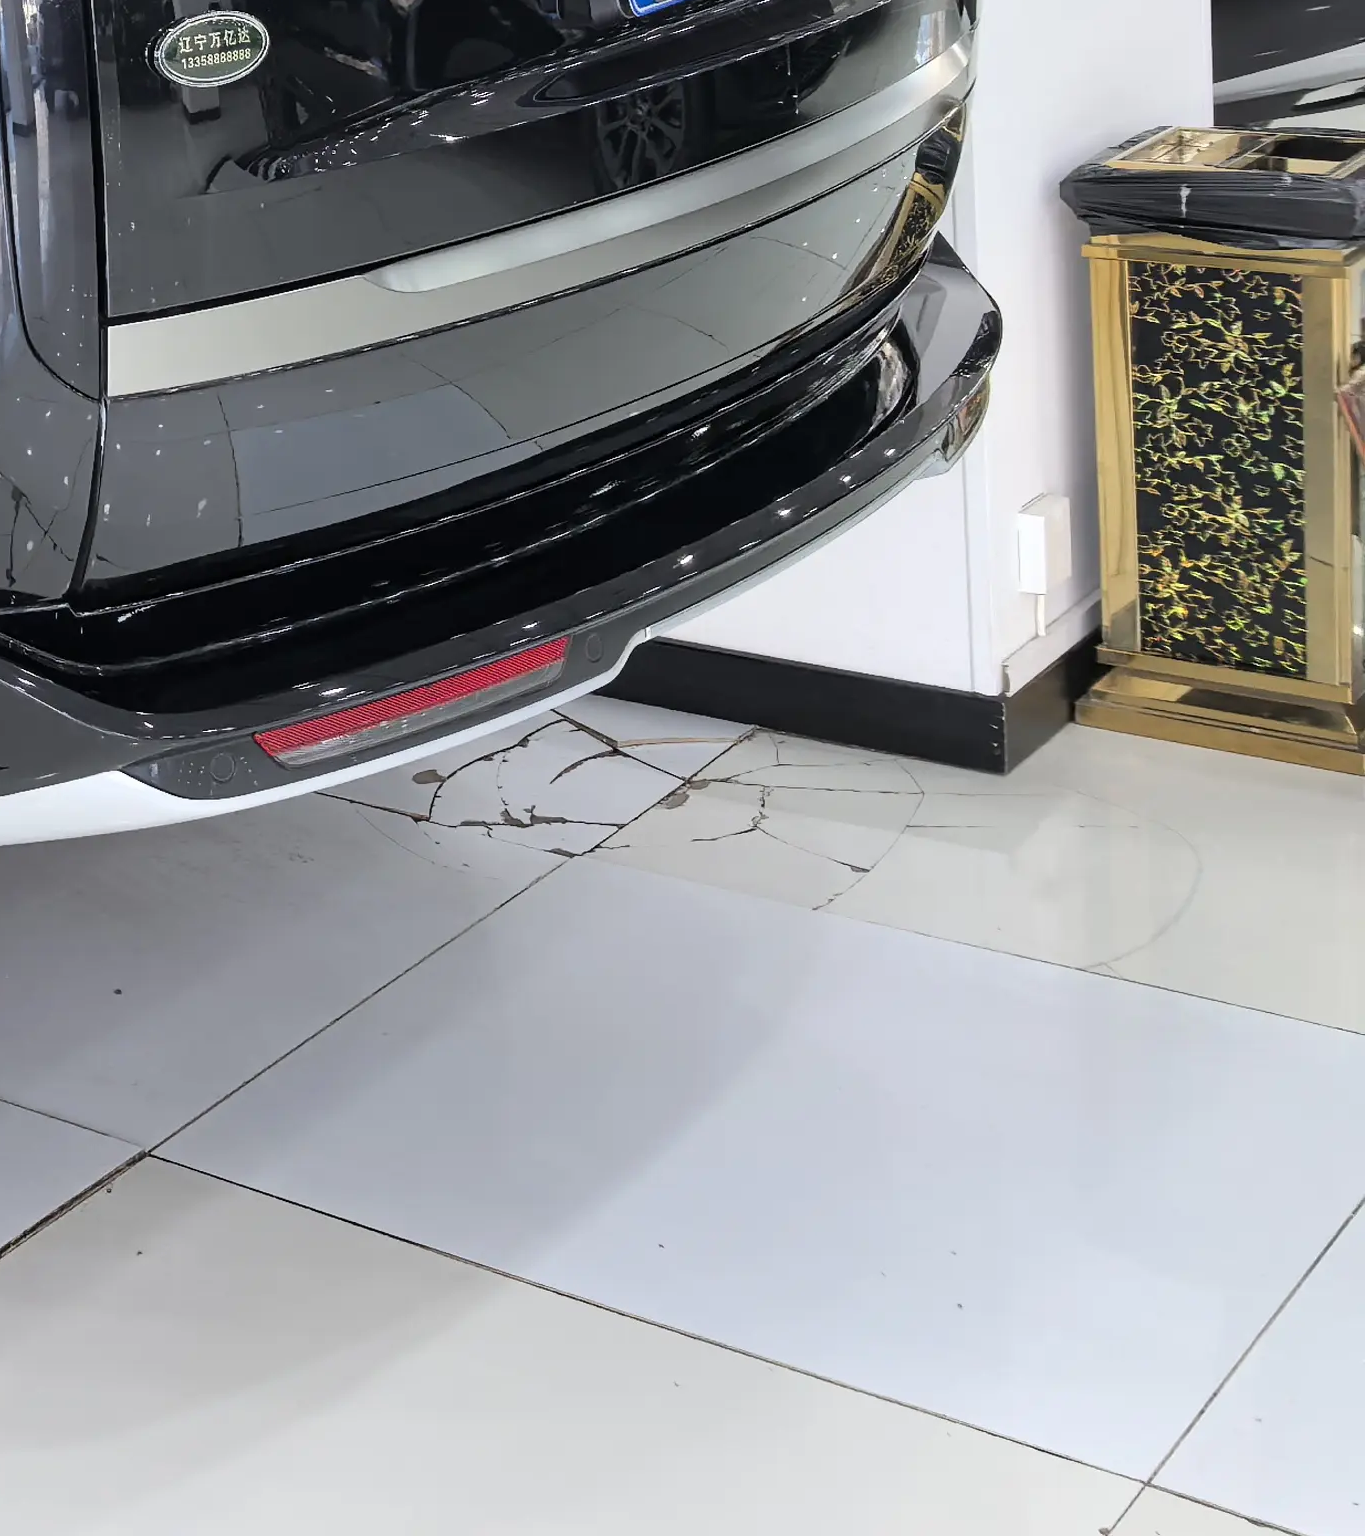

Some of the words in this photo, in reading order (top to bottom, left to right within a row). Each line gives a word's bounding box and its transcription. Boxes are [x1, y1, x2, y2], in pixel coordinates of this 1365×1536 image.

[178, 26, 251, 54] 辽宁万亿达
[181, 48, 251, 70] 13358888888
